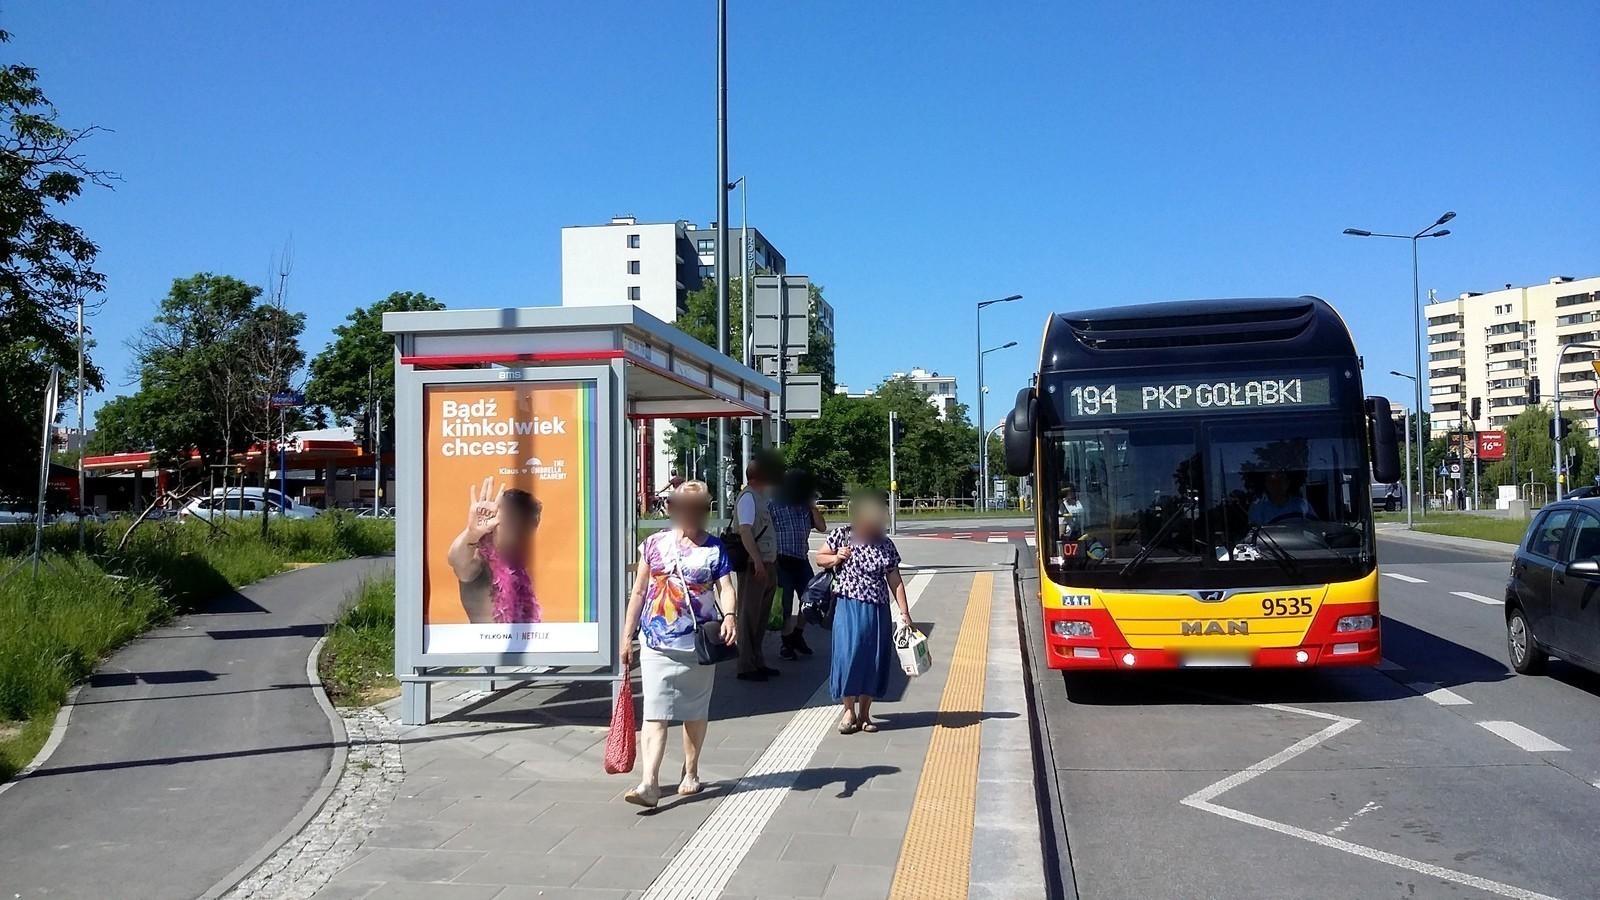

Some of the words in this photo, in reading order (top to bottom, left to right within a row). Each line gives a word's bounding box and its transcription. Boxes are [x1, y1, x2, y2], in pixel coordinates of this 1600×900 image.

[498, 371, 521, 379] ams
[1071, 384, 1117, 416] 194
[1142, 384, 1192, 410] PKP
[1195, 379, 1302, 408] GOŁĄBKI
[442, 398, 498, 423] Bądź
[442, 416, 567, 437] kimkolwiek
[441, 438, 520, 457] chcesz
[1063, 543, 1078, 556] 07
[1261, 597, 1313, 616] 9535
[521, 631, 550, 641] NETFLIX
[1181, 620, 1249, 636] MAN
